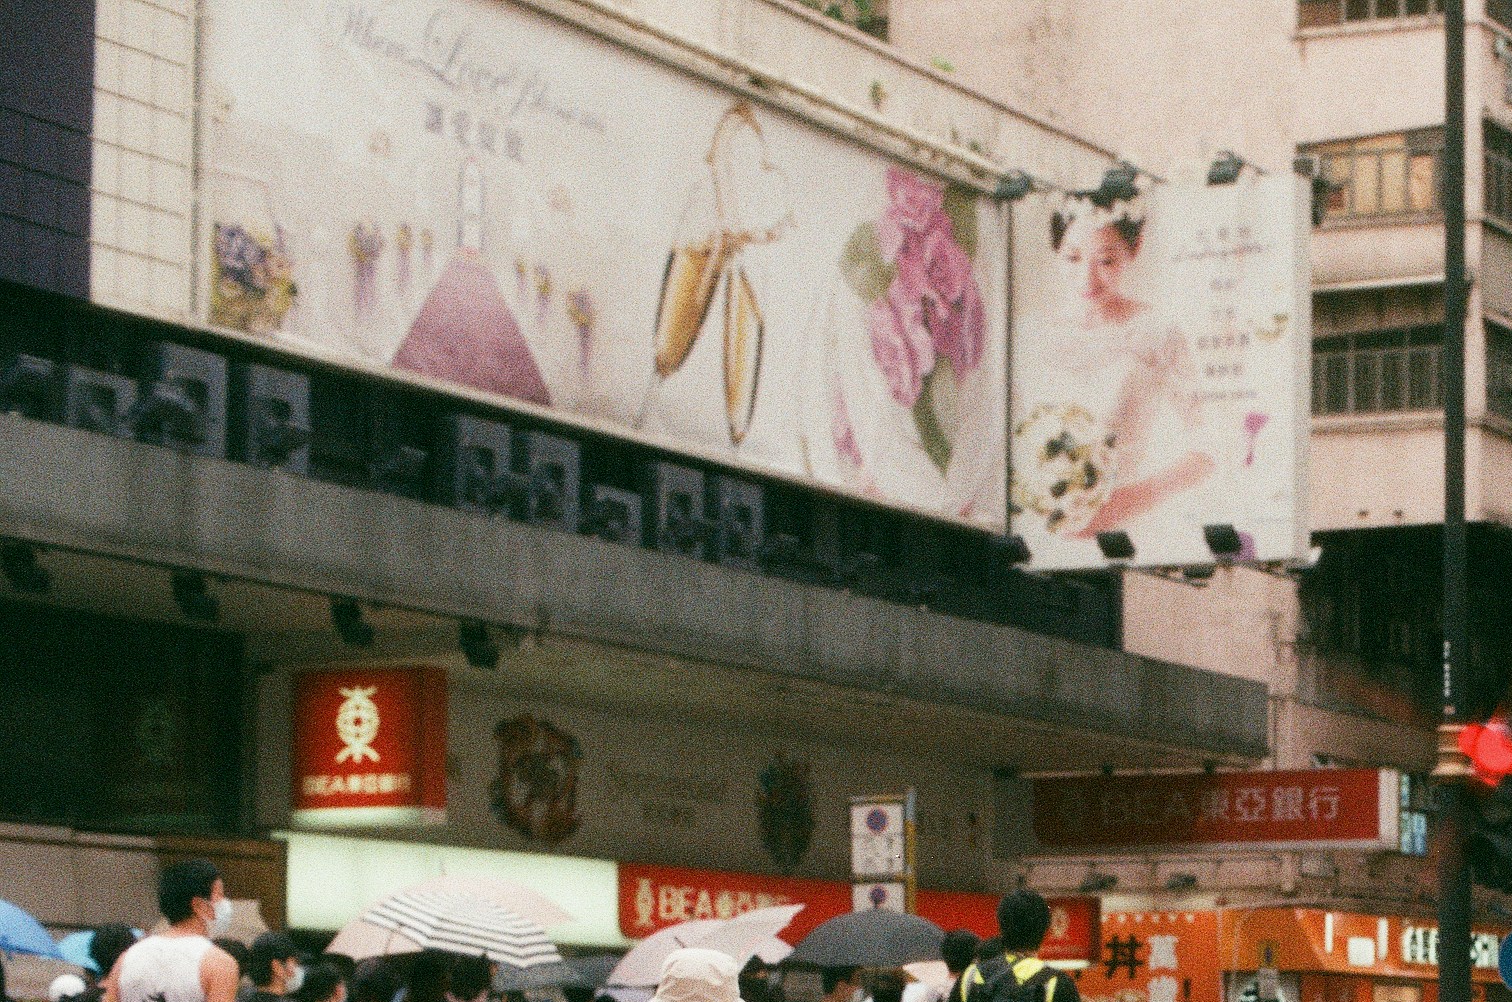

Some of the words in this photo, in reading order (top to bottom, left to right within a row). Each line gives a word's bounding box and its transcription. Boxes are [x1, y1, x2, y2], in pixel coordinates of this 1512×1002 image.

[1101, 789, 1194, 824] BEA
[1201, 786, 1341, 822] 東亞銀行
[659, 885, 713, 920] BEA
